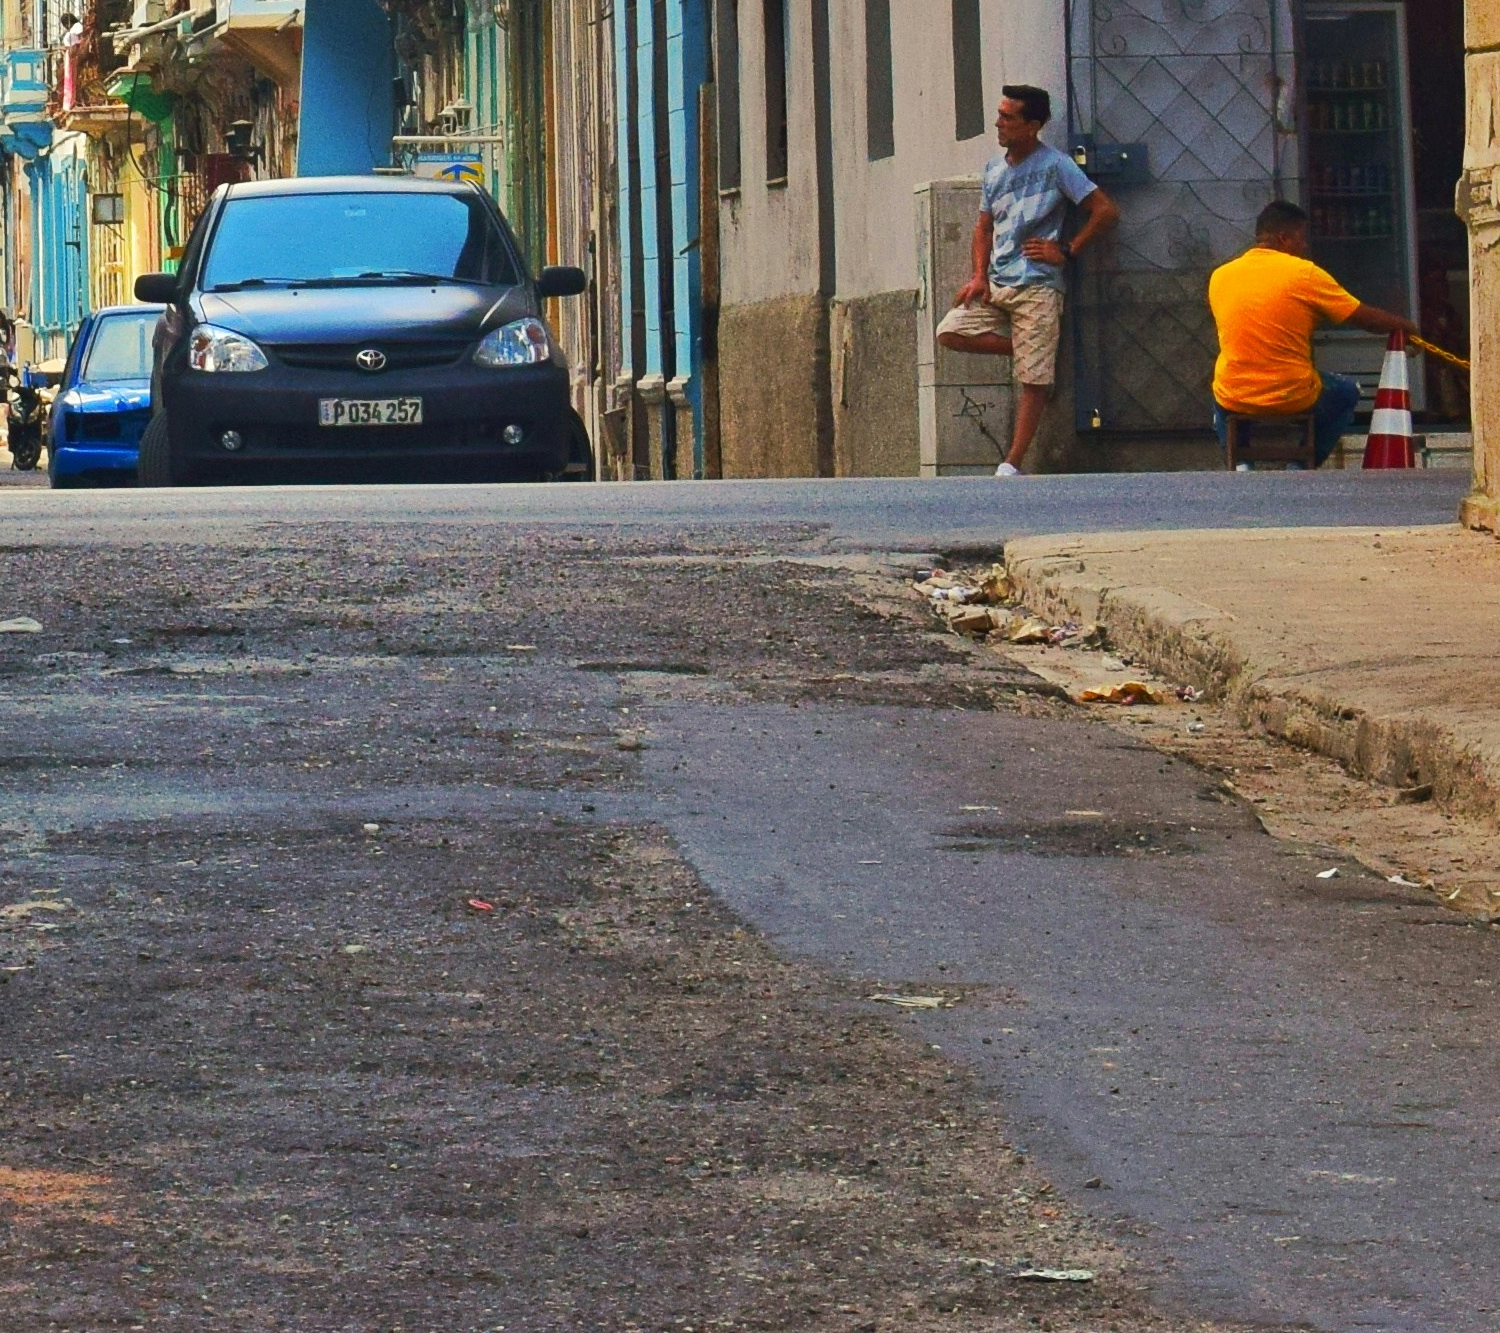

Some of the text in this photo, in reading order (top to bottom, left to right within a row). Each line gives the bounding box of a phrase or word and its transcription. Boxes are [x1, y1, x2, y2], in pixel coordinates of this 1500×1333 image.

[333, 401, 345, 423] P
[348, 402, 382, 422] 034
[386, 400, 420, 422] 257
